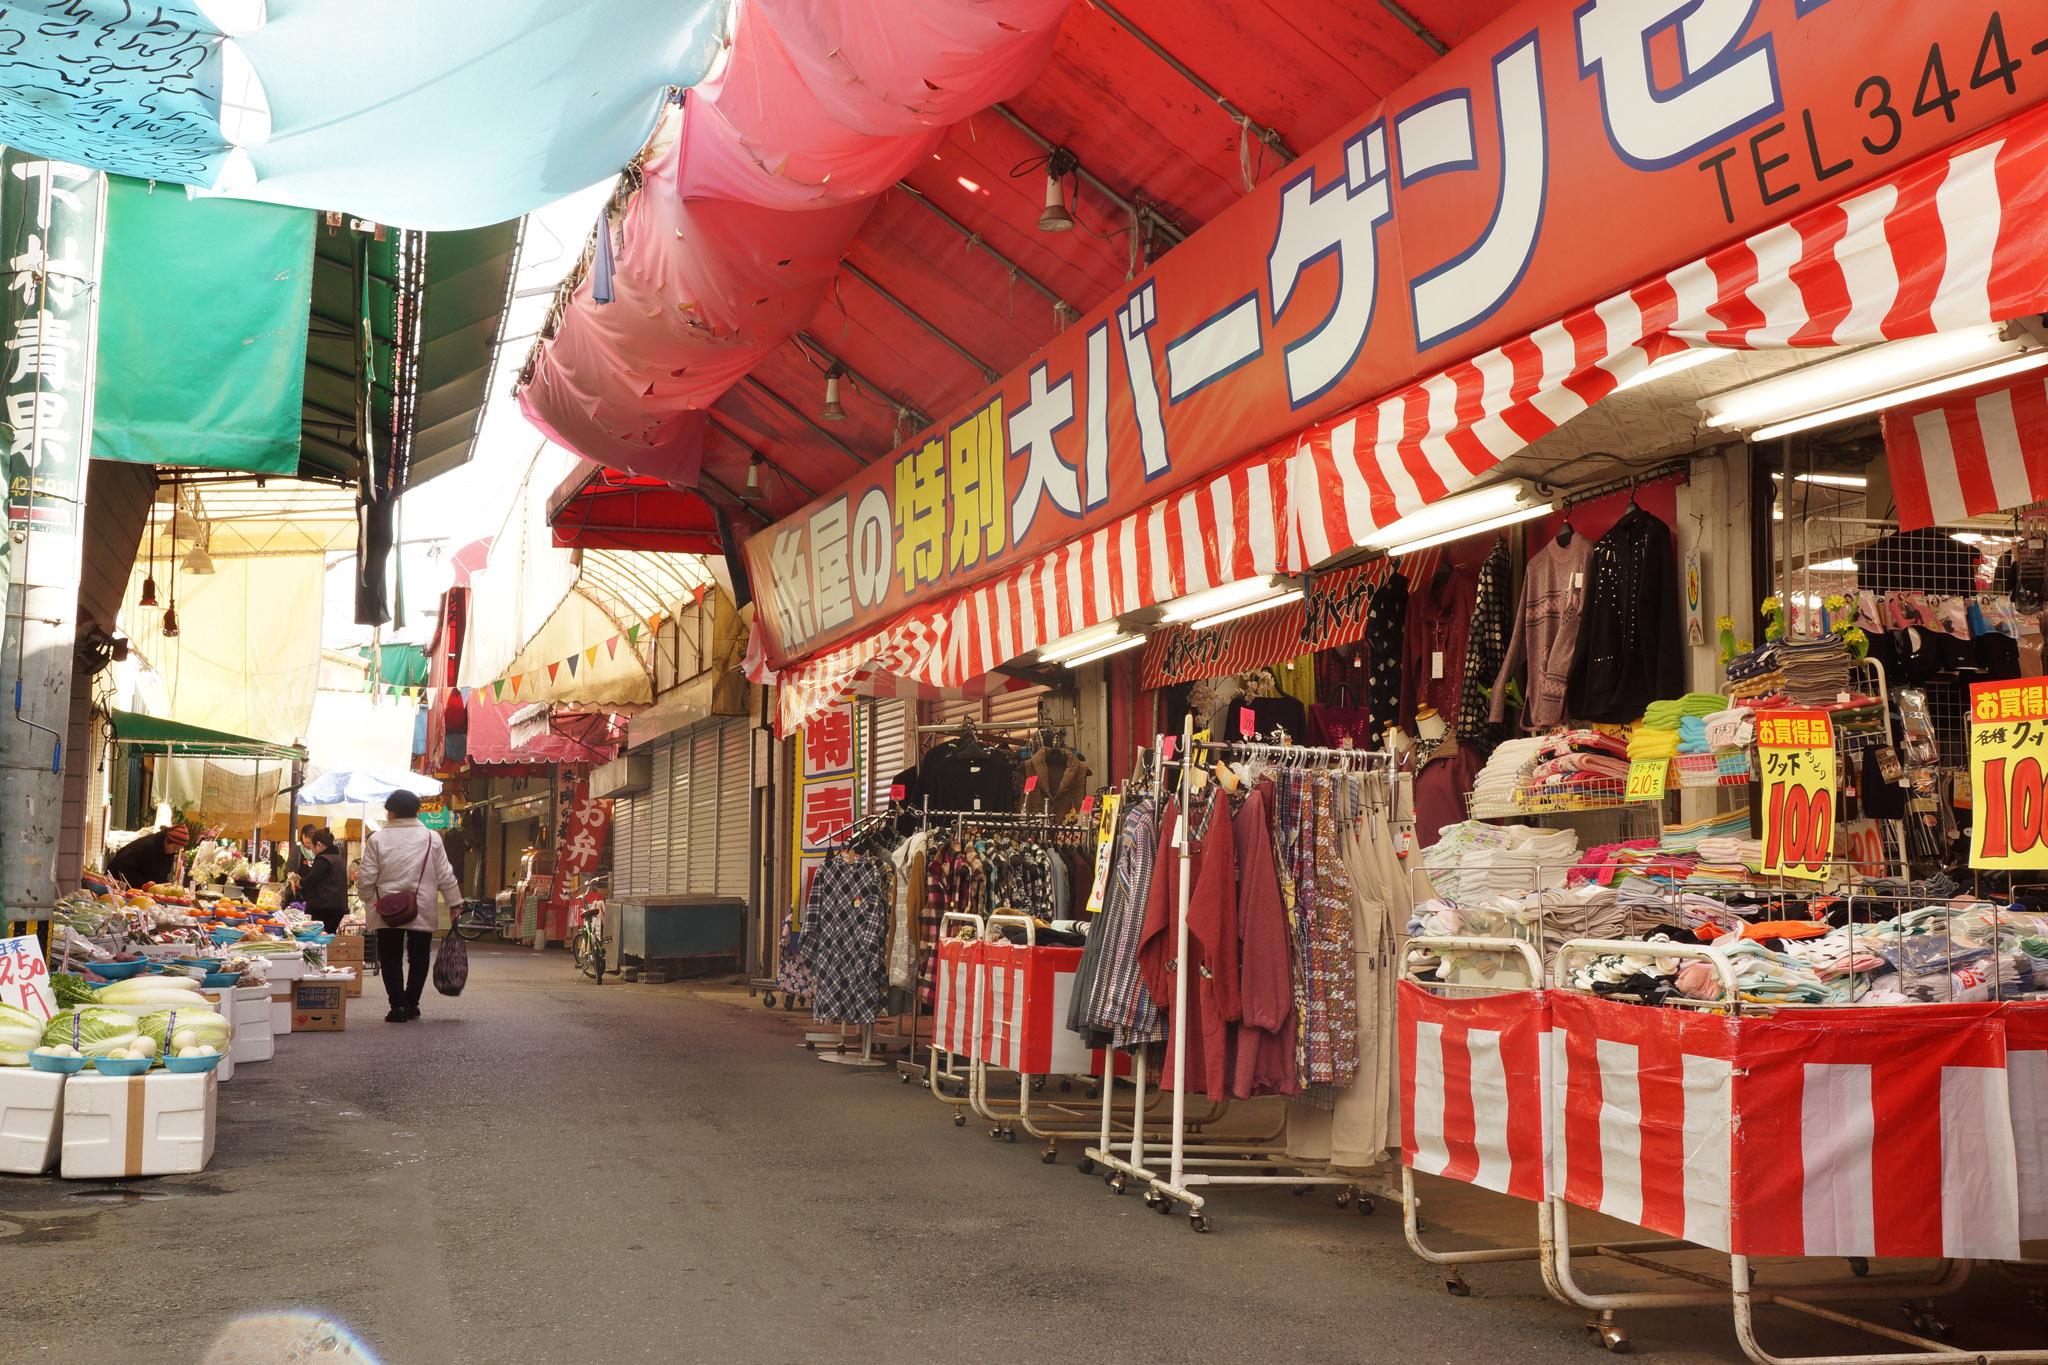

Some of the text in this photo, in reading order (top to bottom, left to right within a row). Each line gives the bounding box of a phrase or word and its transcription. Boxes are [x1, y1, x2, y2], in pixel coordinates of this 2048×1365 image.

[4, 160, 90, 468] 下村青果
[1976, 686, 2048, 721] お買得
[1759, 719, 1829, 745] お買得品
[1975, 727, 2008, 745] 各種
[1767, 752, 1801, 777] クッ下
[1629, 774, 1653, 795] 210
[1980, 756, 2048, 858] 10
[1764, 781, 1832, 873] 100
[19, 982, 52, 1021] 円
